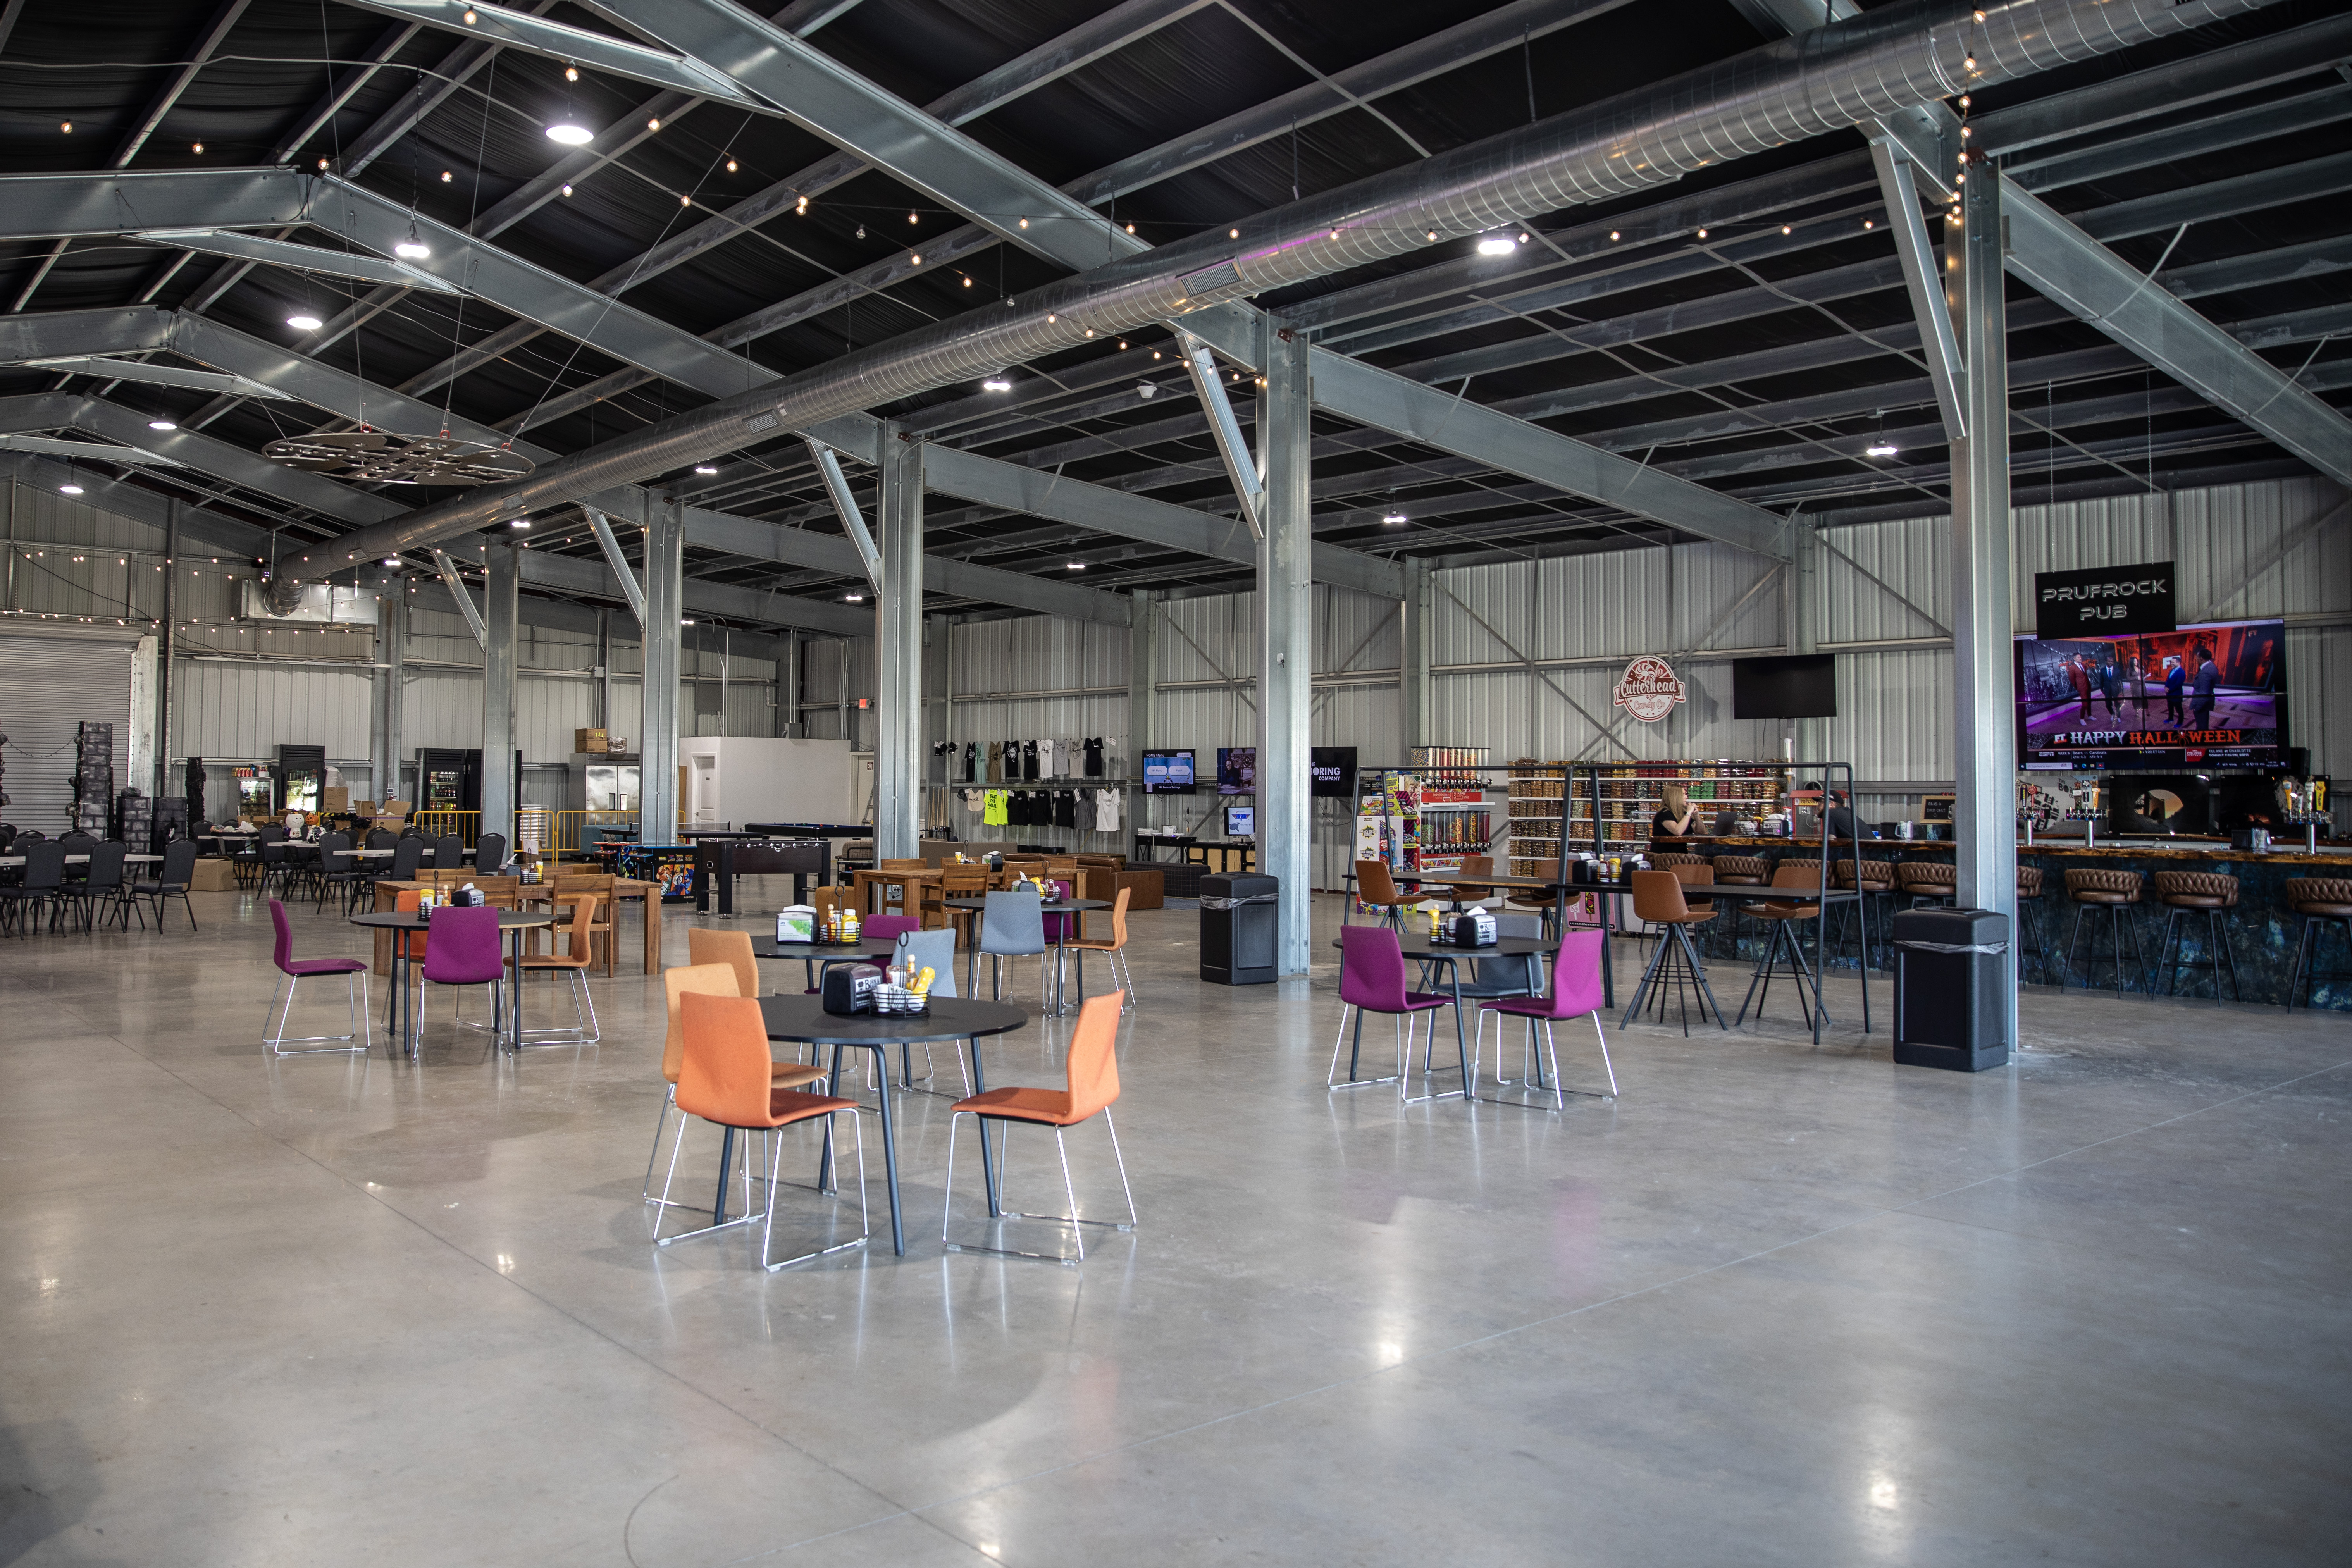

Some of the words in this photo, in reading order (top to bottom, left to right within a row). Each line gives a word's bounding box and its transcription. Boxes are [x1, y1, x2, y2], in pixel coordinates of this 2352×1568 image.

[2042, 579, 2167, 602] PRUFROCK
[2080, 604, 2127, 620] PUB
[1620, 678, 1676, 697] Cutterhead
[1634, 699, 1655, 711] Candy
[1656, 699, 1665, 709] Co
[2070, 731, 2126, 745] HAPPY
